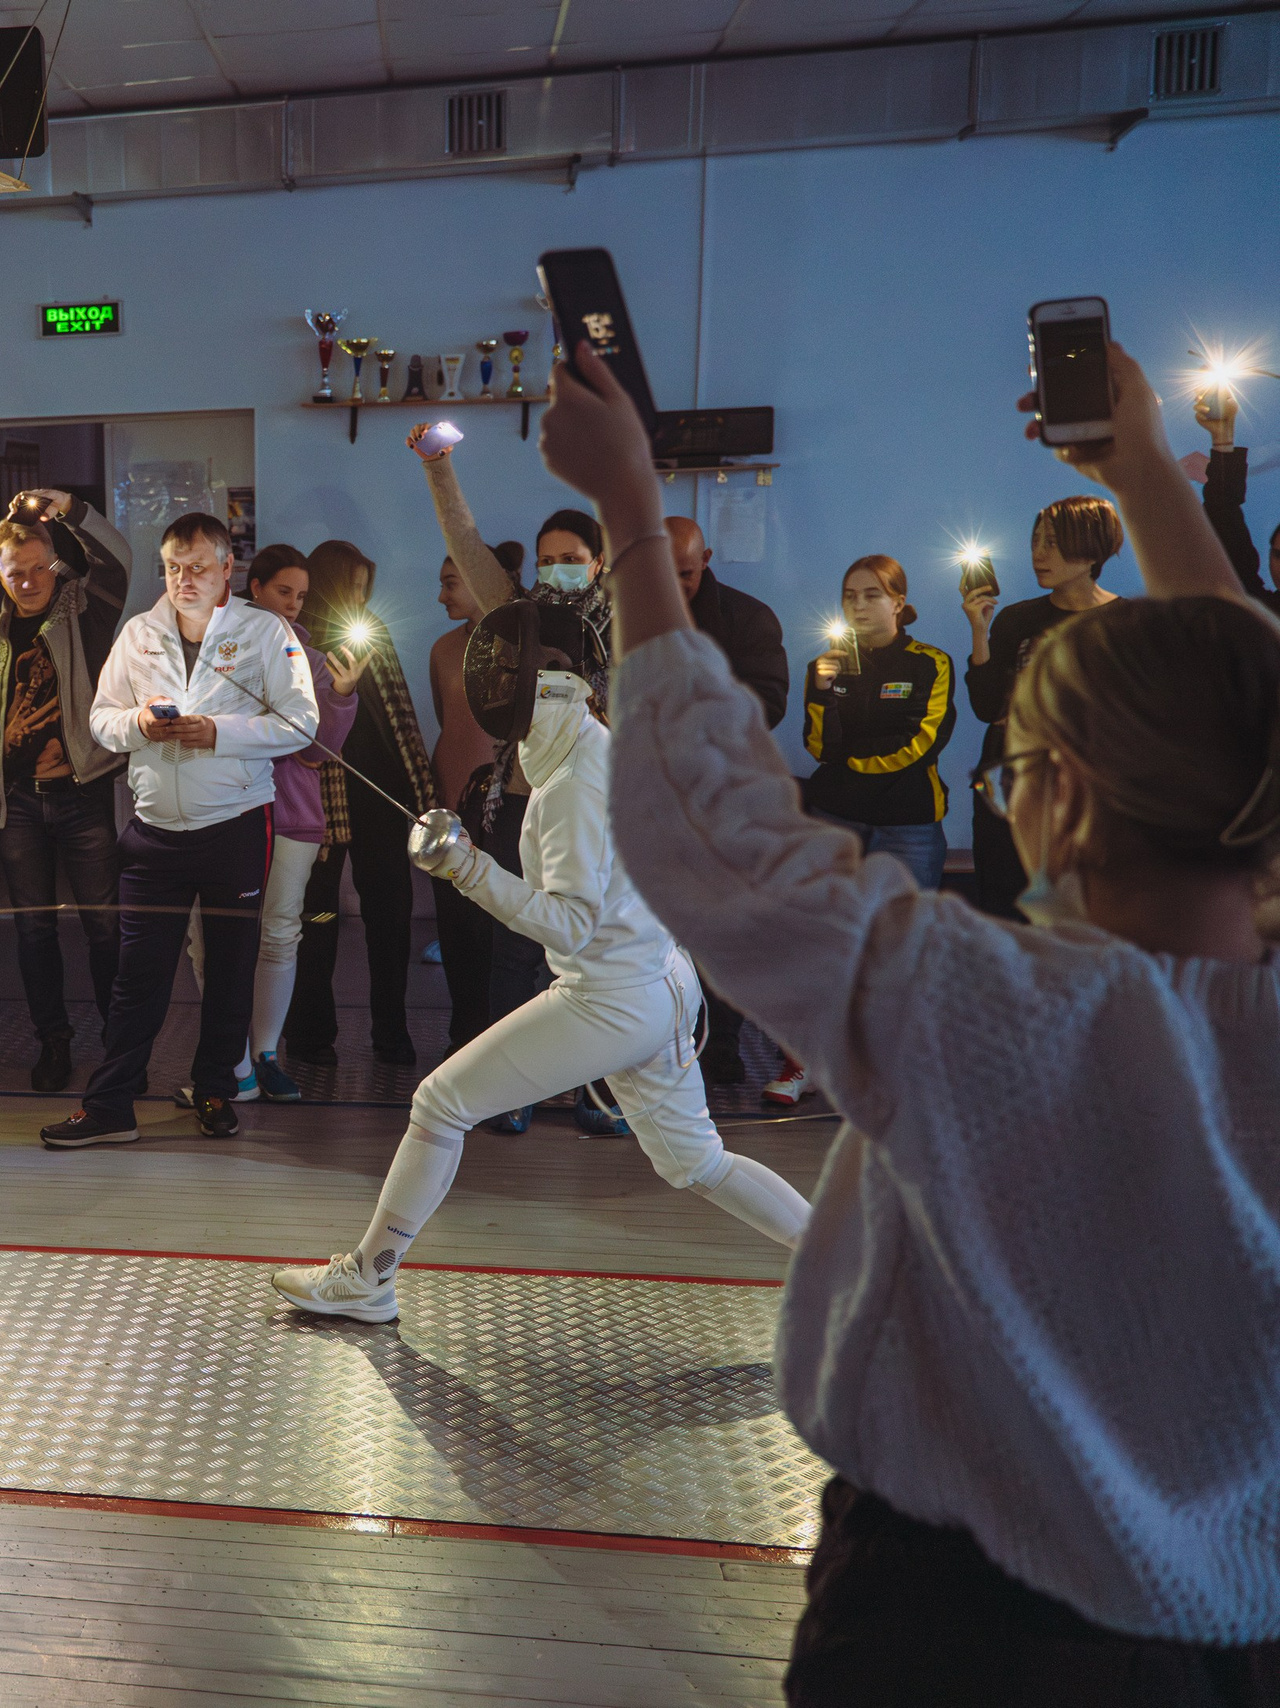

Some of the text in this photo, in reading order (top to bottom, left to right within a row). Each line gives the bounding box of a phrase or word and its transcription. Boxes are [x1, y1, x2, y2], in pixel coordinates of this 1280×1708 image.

[46, 305, 114, 322] ВЫХОД
[56, 319, 105, 333] EXIT
[214, 665, 236, 673] RUS
